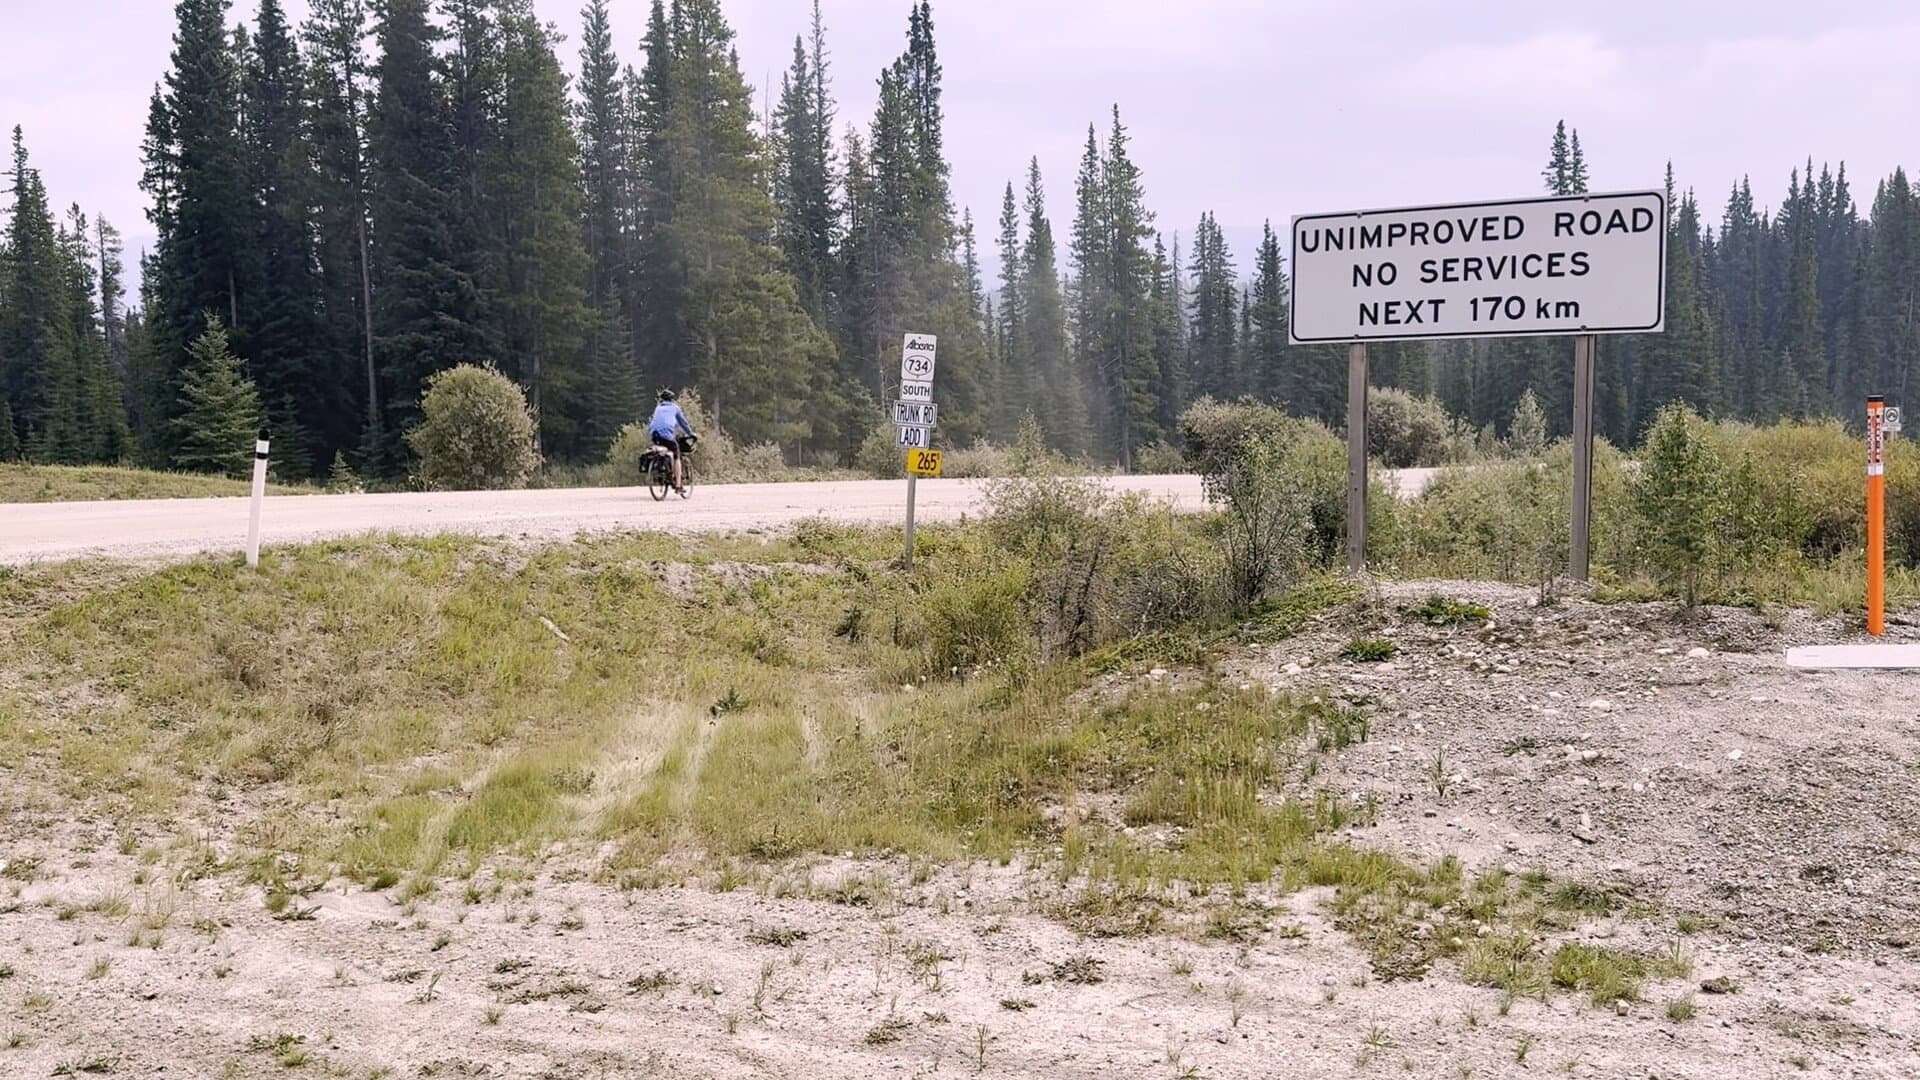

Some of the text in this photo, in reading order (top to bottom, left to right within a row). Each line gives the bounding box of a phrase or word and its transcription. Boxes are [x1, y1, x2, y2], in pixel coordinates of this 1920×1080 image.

[1300, 207, 1655, 253] UNIMPROVED ROAD
[1352, 251, 1591, 287] NO SERVICES
[1358, 295, 1580, 326] NEXT 170 km
[905, 338, 935, 351] Alberta
[908, 359, 929, 374] 734
[902, 385, 930, 397] SOUTH
[896, 403, 934, 424] TRUNK RD
[899, 427, 921, 446] LADD
